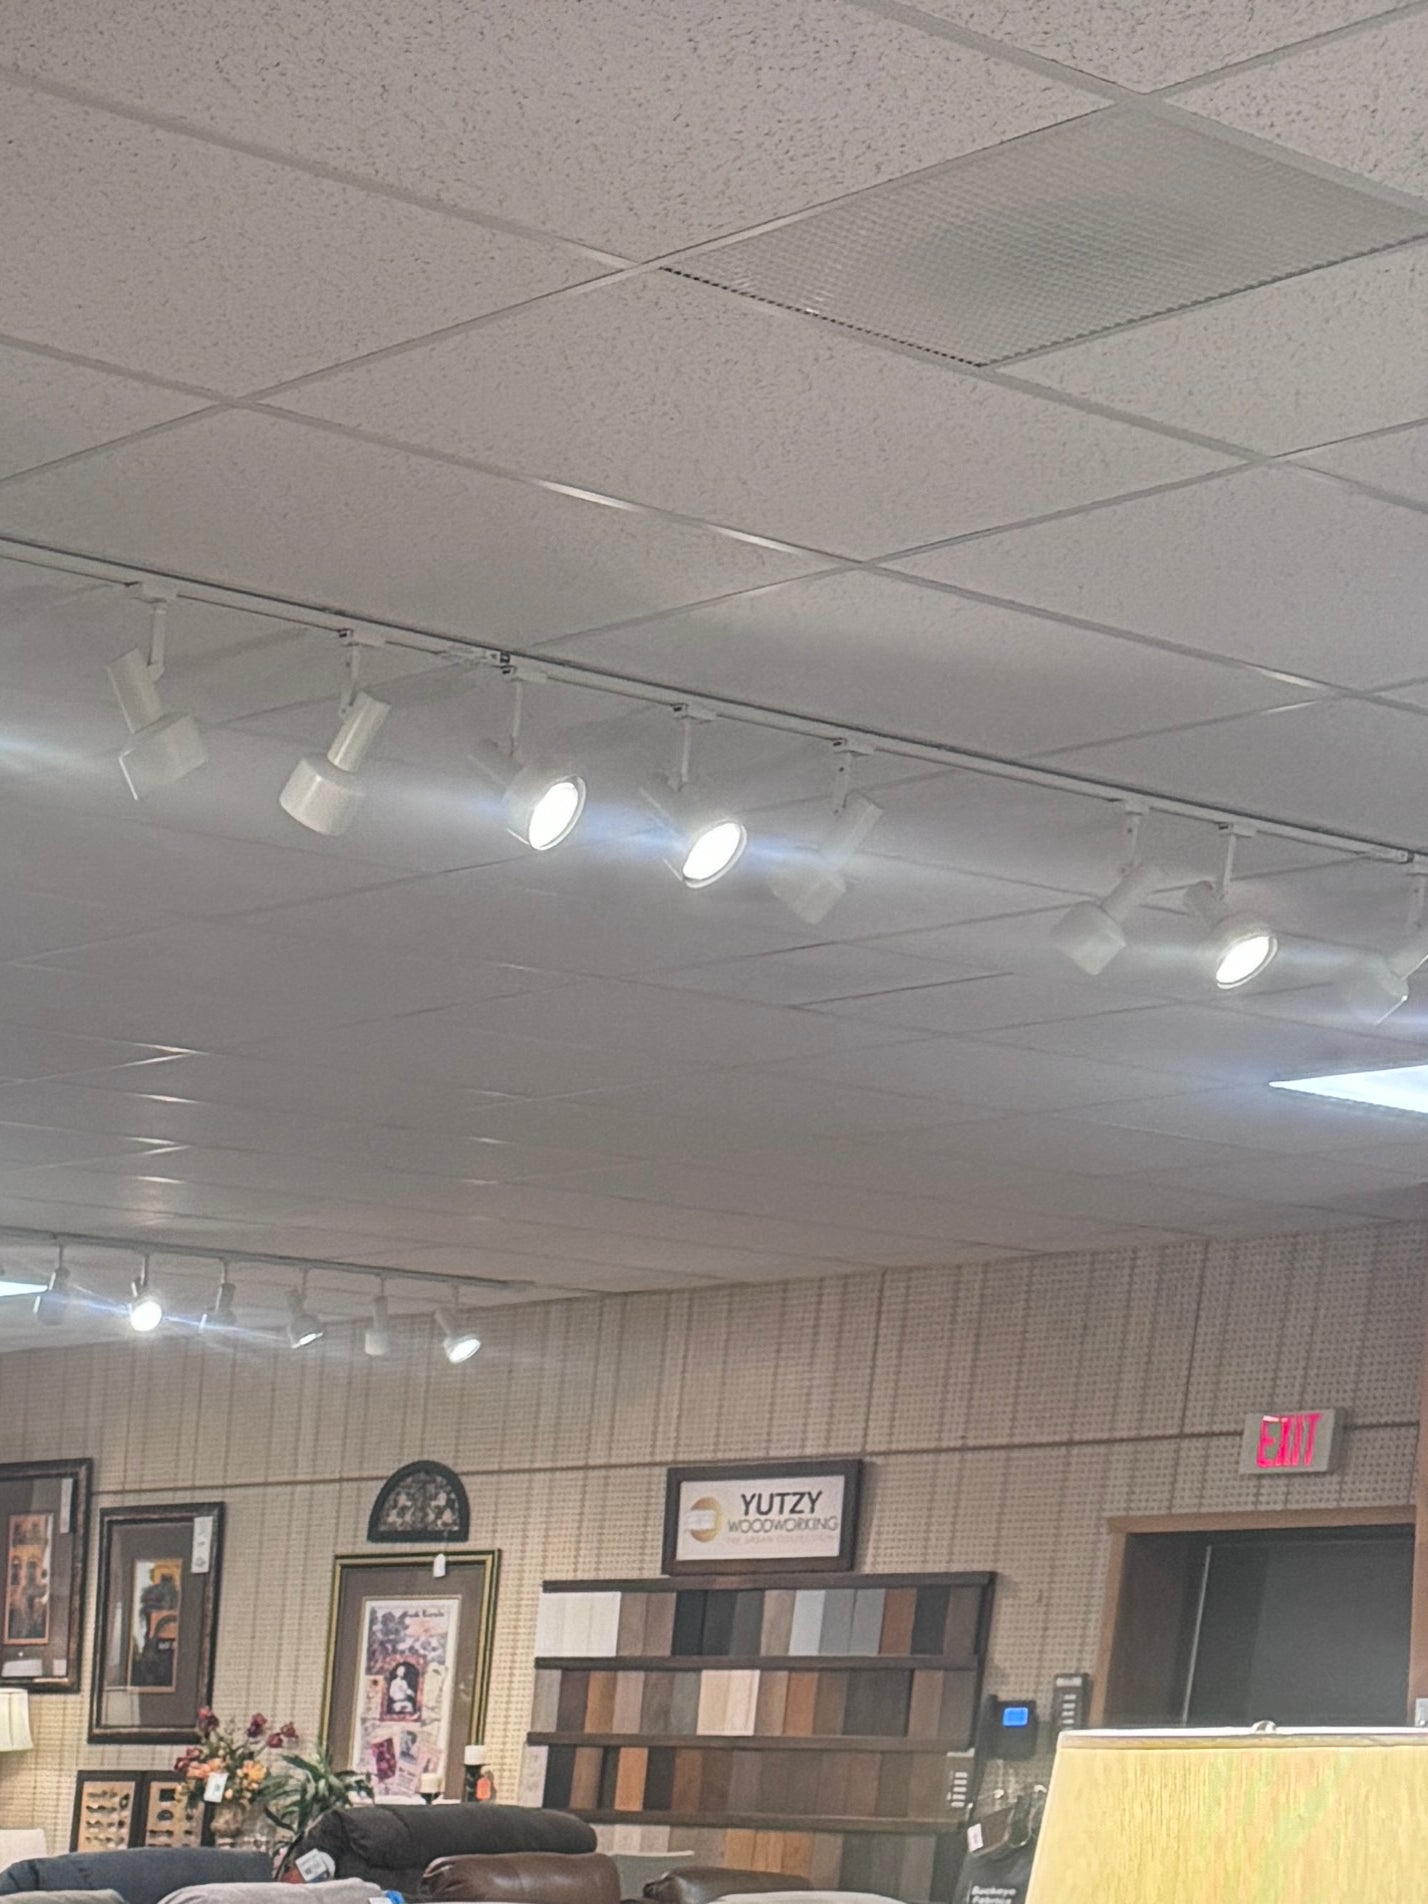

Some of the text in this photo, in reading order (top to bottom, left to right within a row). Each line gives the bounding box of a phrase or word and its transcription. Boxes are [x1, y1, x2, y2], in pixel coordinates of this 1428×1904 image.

[1256, 1414, 1321, 1468] EXIT
[741, 1490, 823, 1516] YUTZY
[727, 1515, 838, 1533] WOODWORKING
